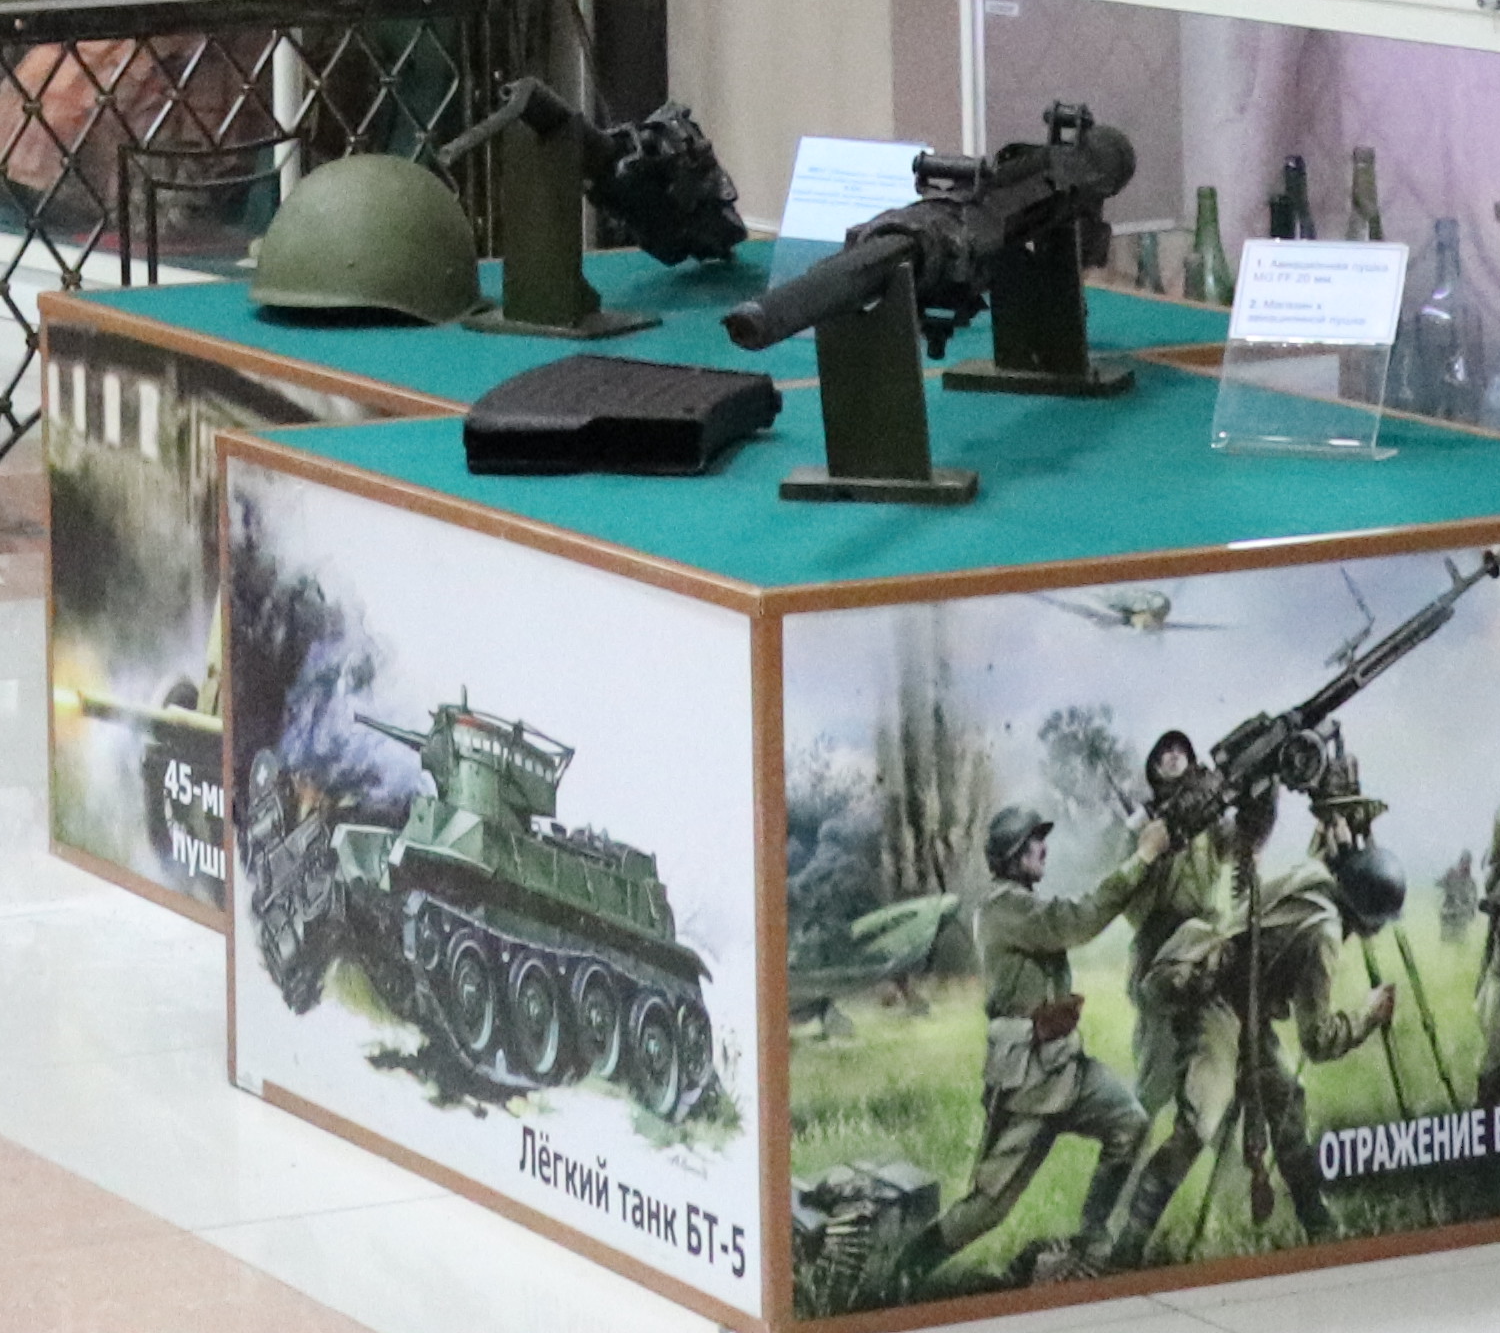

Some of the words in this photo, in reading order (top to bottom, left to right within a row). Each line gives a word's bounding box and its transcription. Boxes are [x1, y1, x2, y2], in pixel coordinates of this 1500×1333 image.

[1319, 1108, 1487, 1180] ОТРАЖЕНИЕ
[519, 1125, 610, 1214] Лёгкий
[617, 1181, 678, 1247] танк
[686, 1201, 746, 1278] БТ-5
